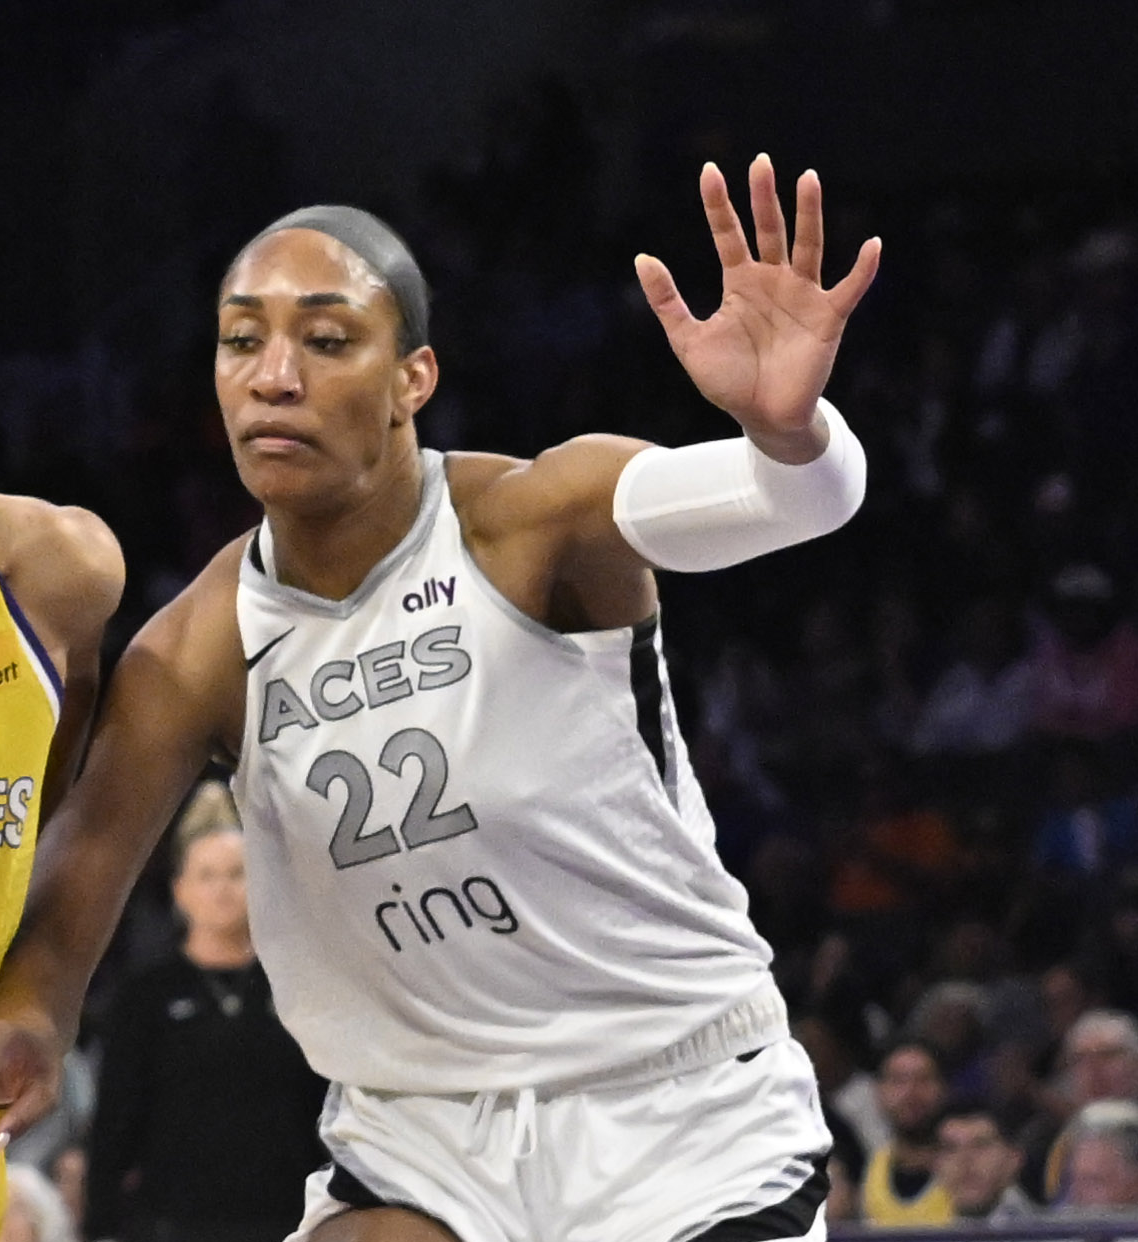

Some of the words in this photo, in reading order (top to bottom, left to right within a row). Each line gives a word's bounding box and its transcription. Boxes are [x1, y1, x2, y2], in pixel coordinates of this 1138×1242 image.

[402, 576, 456, 613] ally
[258, 625, 472, 745] ACES
[305, 727, 479, 870] 22
[375, 876, 519, 953] ring
